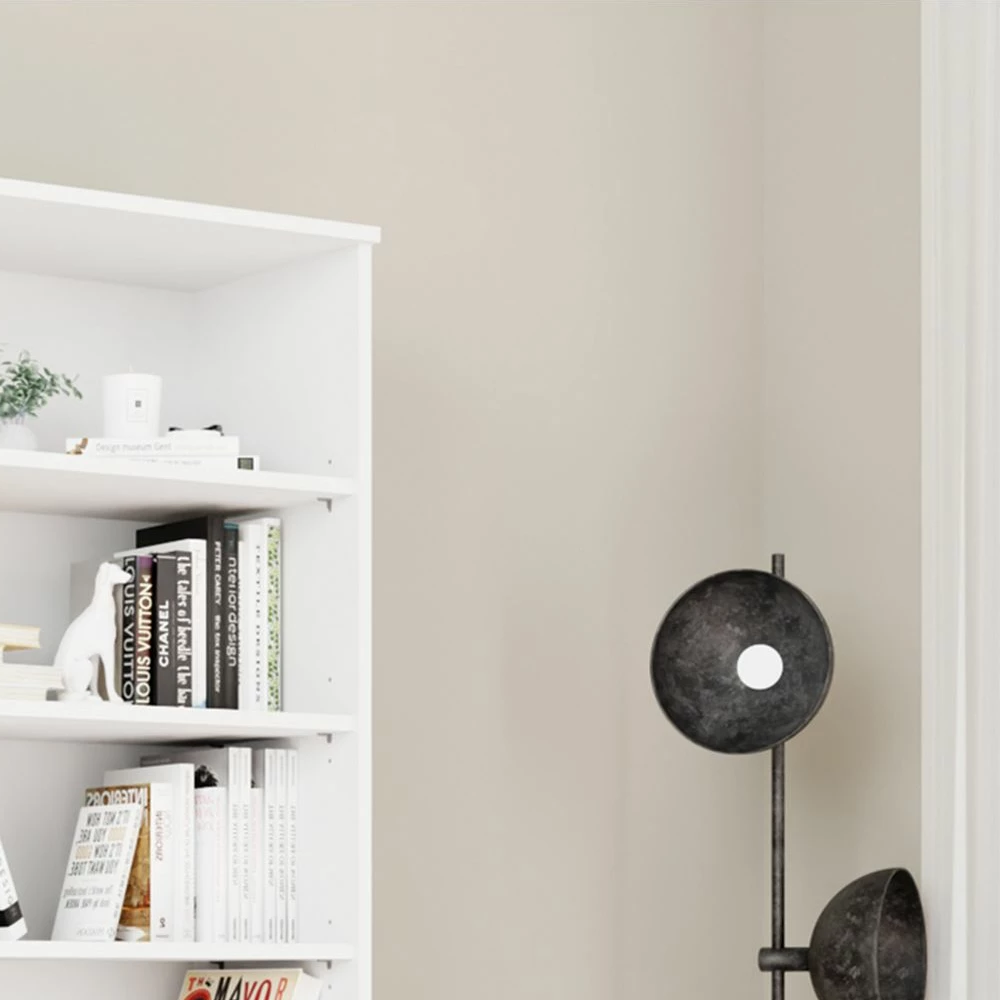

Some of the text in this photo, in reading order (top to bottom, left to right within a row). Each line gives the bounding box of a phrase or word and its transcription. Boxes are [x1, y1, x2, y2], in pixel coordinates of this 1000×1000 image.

[177, 556, 192, 575] the
[213, 541, 222, 605] PETER CAREY
[177, 580, 192, 607] tales
[158, 600, 170, 667] CHANEL
[177, 609, 192, 625] of
[123, 623, 136, 700] VUITTO
[137, 583, 153, 704] LOUIS VUITTON
[177, 626, 192, 662] beedle
[177, 666, 192, 686] the
